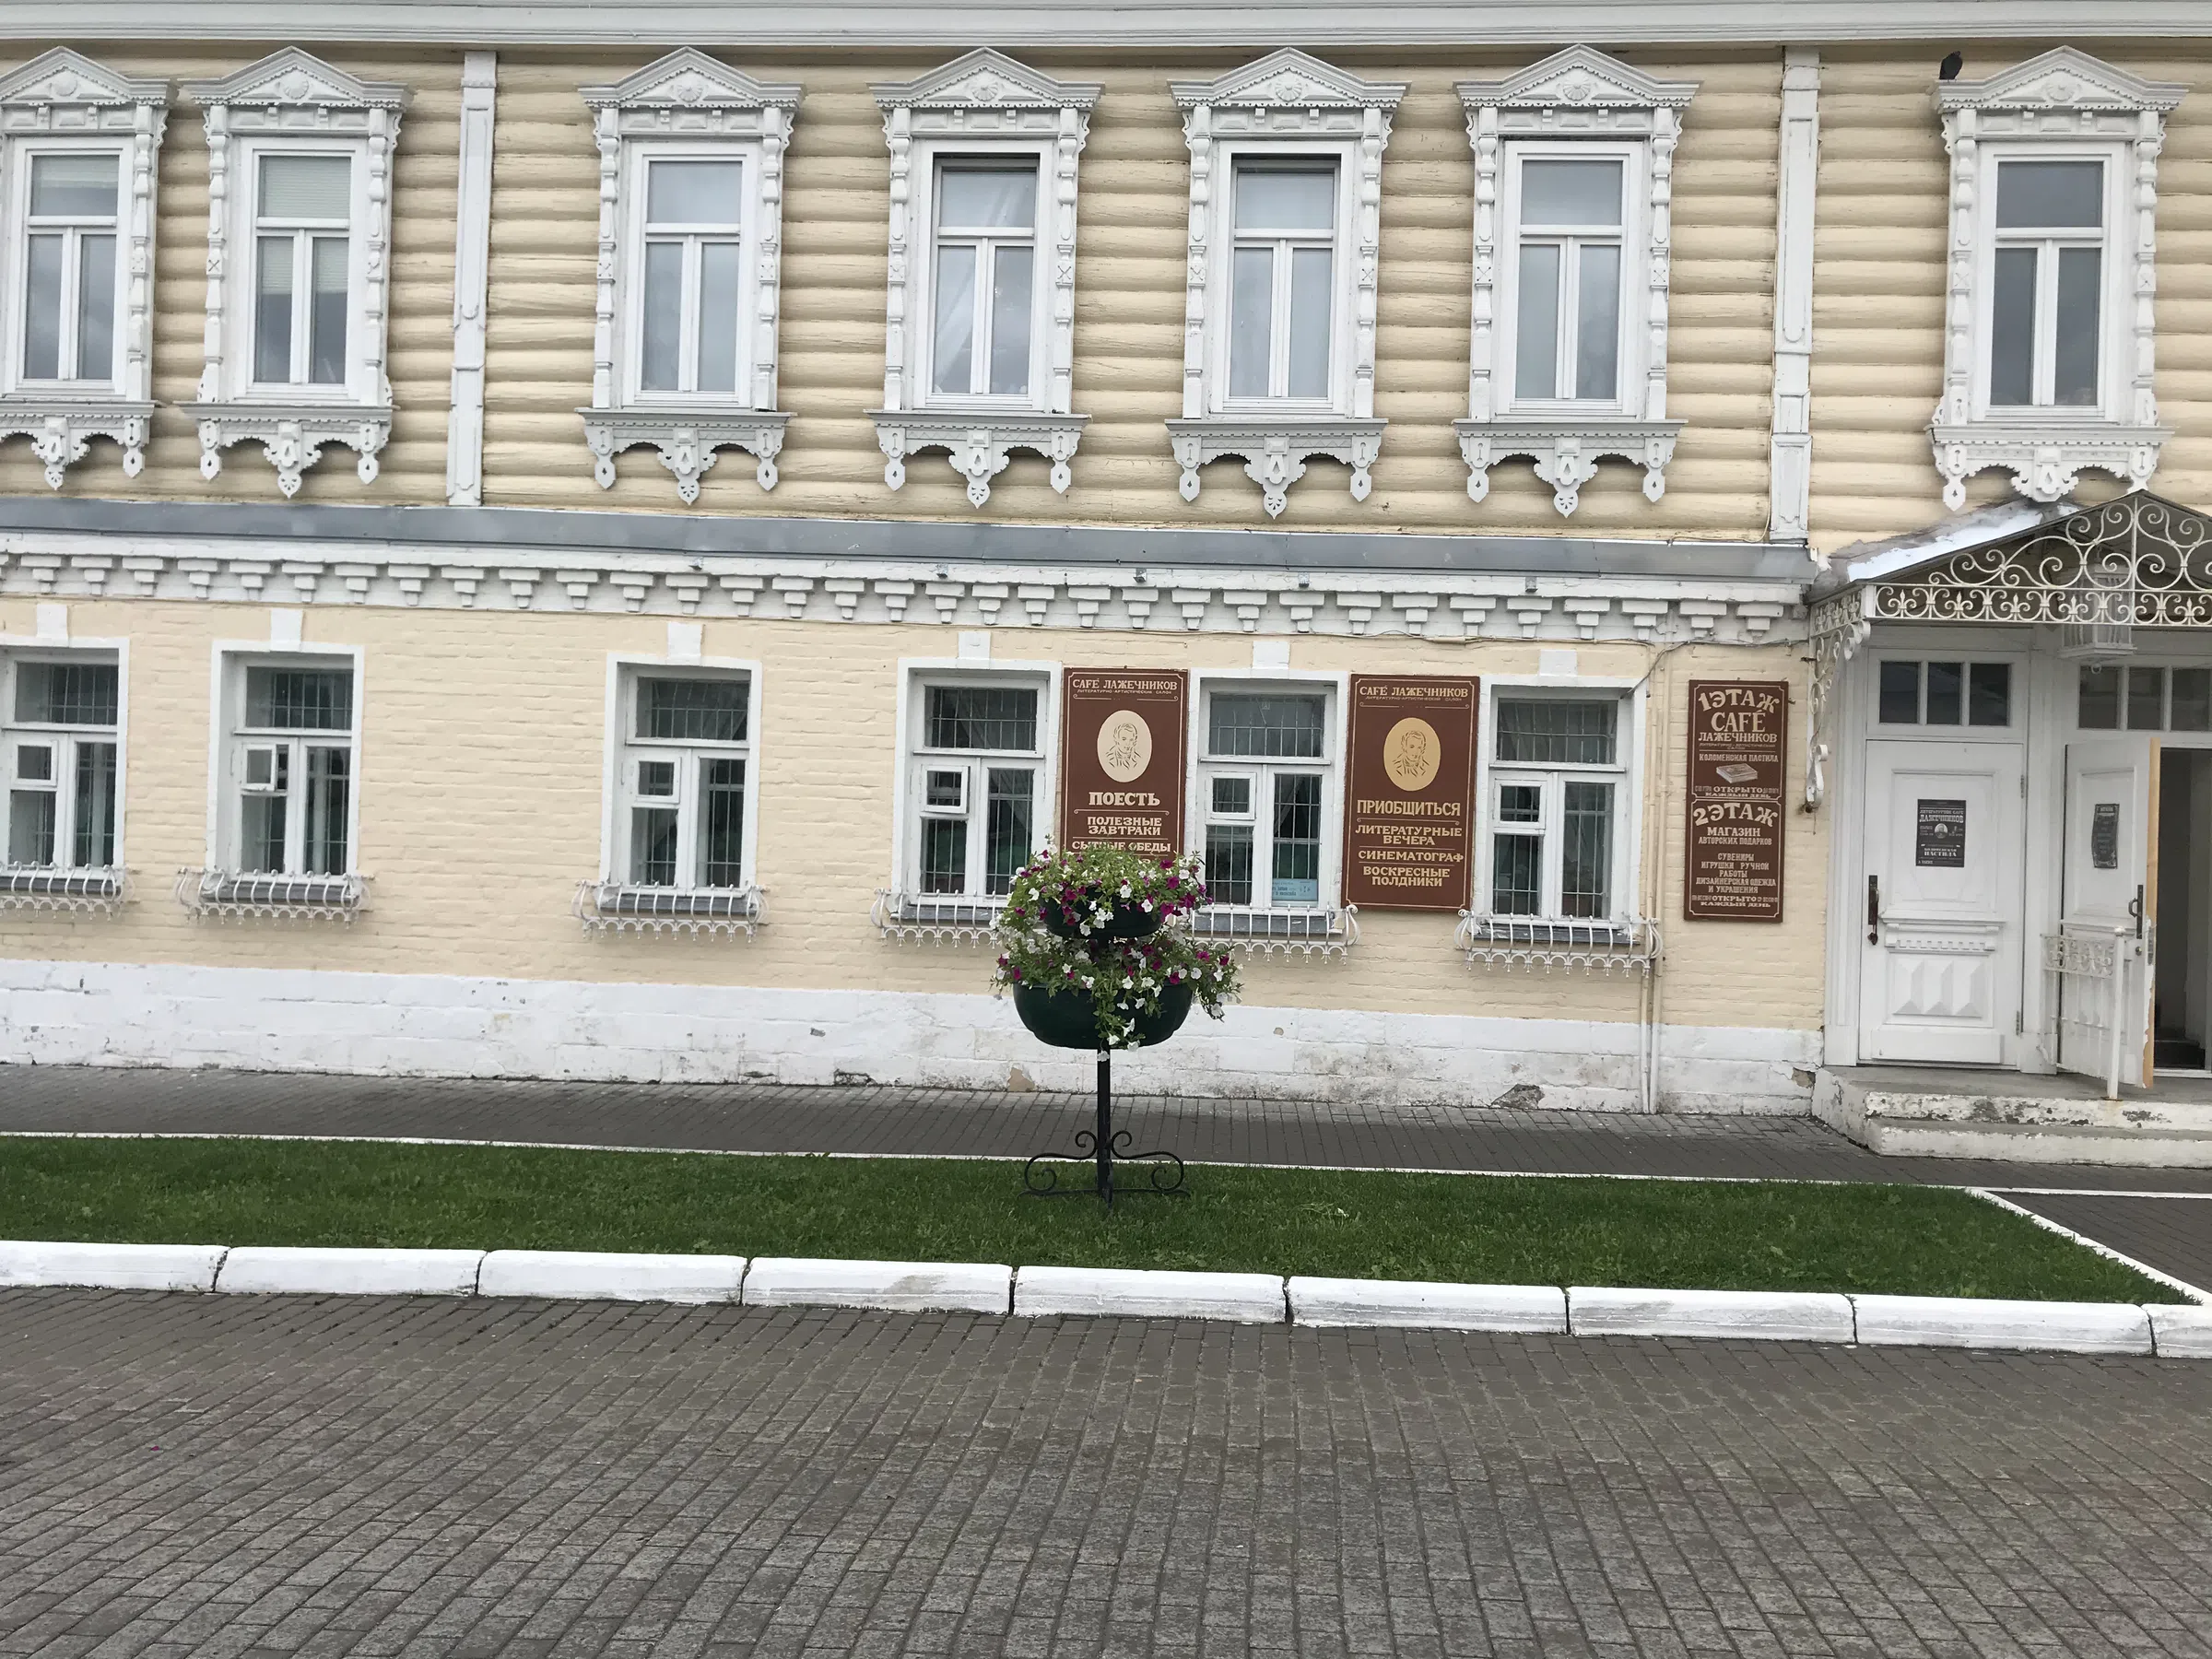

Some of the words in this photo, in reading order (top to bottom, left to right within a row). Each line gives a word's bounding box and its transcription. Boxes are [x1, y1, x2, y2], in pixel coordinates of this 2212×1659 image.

[1072, 677, 1100, 688] CAFÉ
[1103, 679, 1178, 690] ЛАЖЕЧНИКОВ
[1359, 685, 1388, 696] CAFÉ
[1391, 687, 1468, 698] ЛАЖЕЧНИКОВ
[1711, 709, 1766, 733] CAFÉ
[1698, 732, 1778, 743] ЛАЖЕЧНИКОВ
[1699, 753, 1747, 762] КОЛОМЕНСКАЯ
[1748, 754, 1779, 762] ПАСТИЛА
[1713, 785, 1763, 794] ОТКРЫТО
[1088, 792, 1160, 806] ПОЕСТЬ
[1357, 799, 1461, 817] ПРИОБЩИТЬСЯ
[1087, 817, 1162, 827] ПОЛЕЗНЫЕ
[1088, 825, 1161, 836] ЗАВТРАКИ
[1355, 824, 1463, 837] ЛИТЕРАТУРНЫЕ
[1707, 827, 1761, 837] МАГАЗИН
[1382, 835, 1435, 846] ВЕЧЕРА
[1699, 836, 1738, 845] АВТОРСКИХ
[1739, 837, 1772, 845] ПОДАРКОВ
[1128, 841, 1171, 853] ОБЕДЫ
[1358, 850, 1464, 862] СИНЕМАТОГРАФ
[1717, 853, 1755, 862] СУВЕНИРЫ
[1363, 865, 1450, 877] ВОСКРЕСНЫЕ
[1700, 861, 1735, 869] ИГРУШКИ
[1740, 862, 1770, 870] РУЧНОЙ
[1371, 876, 1442, 887] ПОЛДНИКИ
[1696, 877, 1749, 886] ДИЗАЙНЕРСКАЯ
[1749, 878, 1777, 887] ОДЕЖДА
[1716, 886, 1759, 894] УКРАШЕНИЯ
